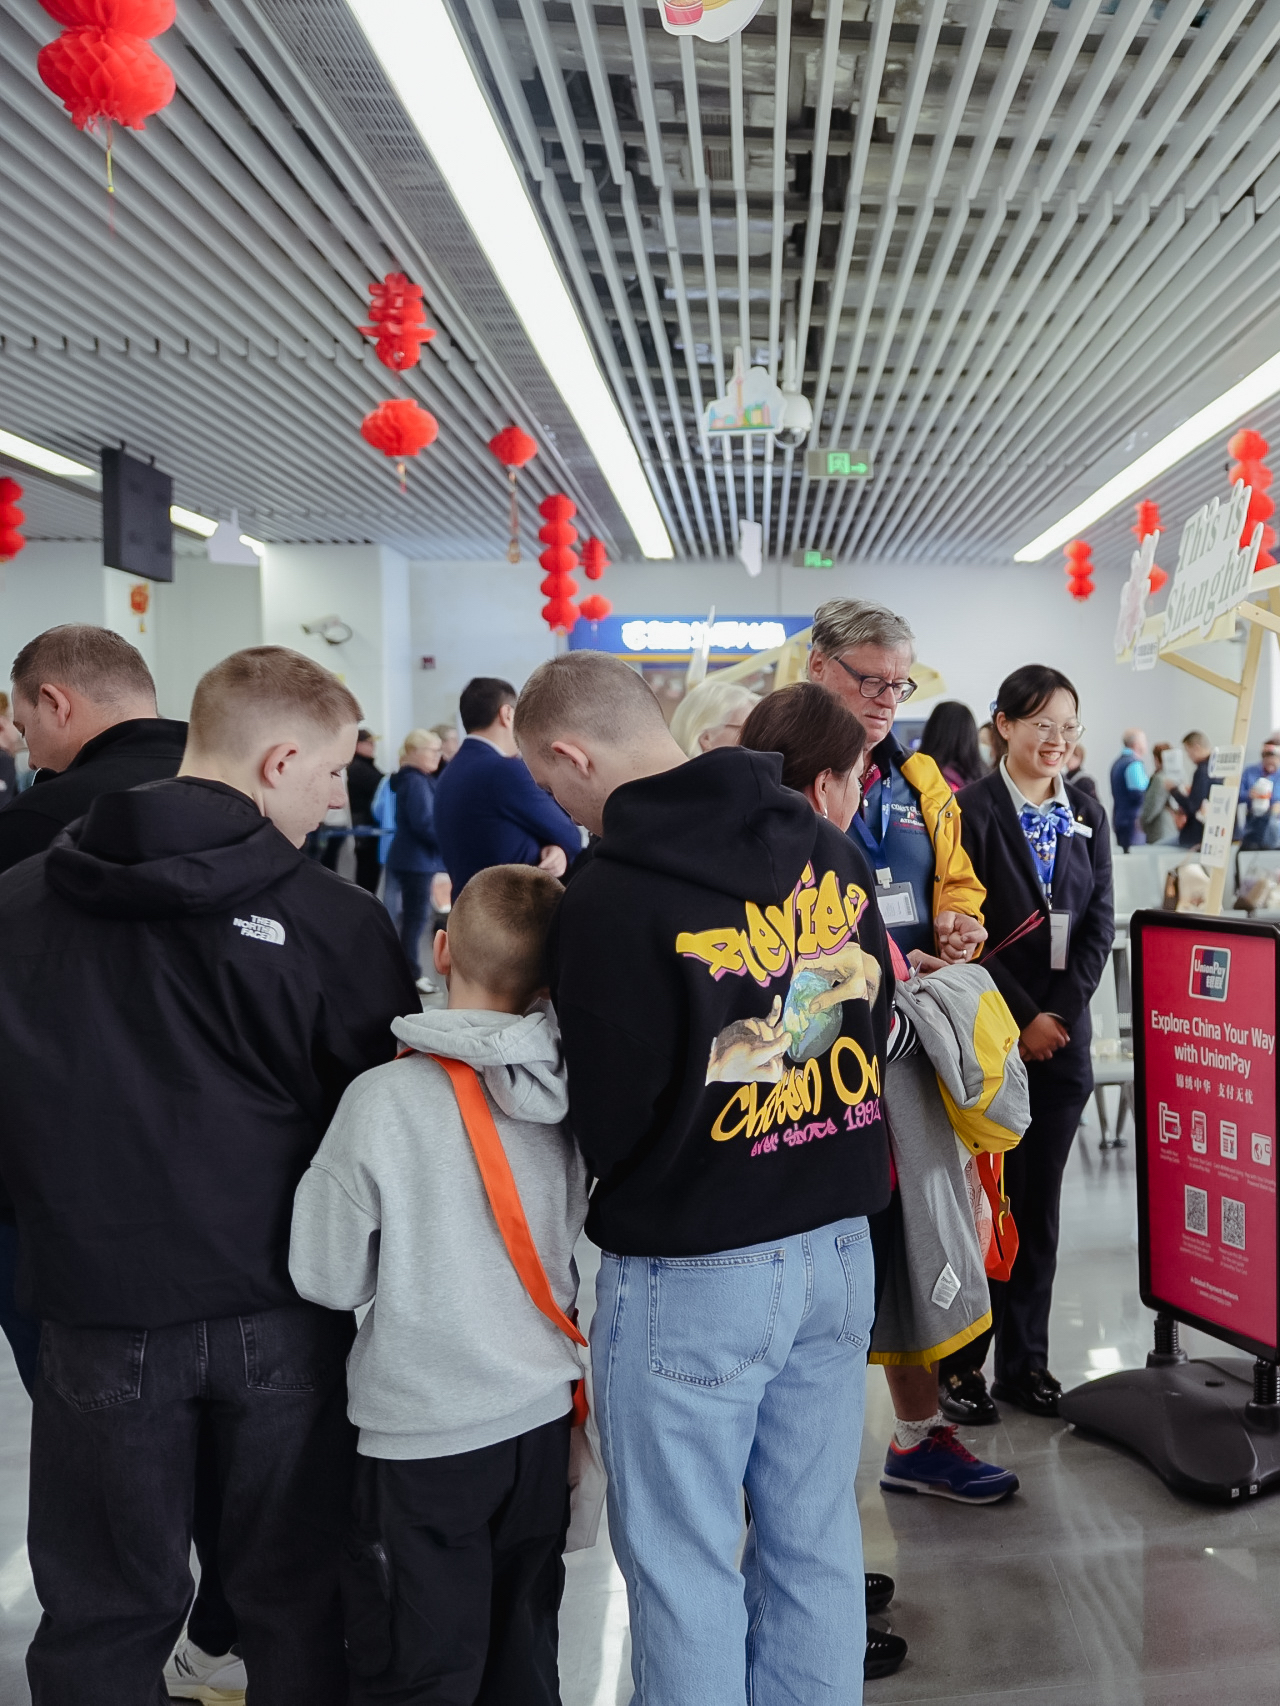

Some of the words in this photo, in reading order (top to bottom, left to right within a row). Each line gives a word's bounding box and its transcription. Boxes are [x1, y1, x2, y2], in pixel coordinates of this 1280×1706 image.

[1178, 505, 1220, 574] This
[1223, 486, 1246, 542] is
[1162, 529, 1261, 638] Shanghai
[232, 917, 271, 933] NORTH
[240, 927, 268, 941] FACE
[250, 914, 272, 926] THE
[1194, 957, 1227, 981] UnionPay
[1151, 1010, 1190, 1035] Explore
[1192, 1017, 1221, 1040] China
[1223, 1022, 1249, 1045] Your
[1251, 1027, 1275, 1055] Way
[1174, 1042, 1198, 1064] with
[1200, 1046, 1251, 1079] UnionPay
[710, 1056, 822, 1142] Chosen
[1218, 1083, 1254, 1105] 支付无忧
